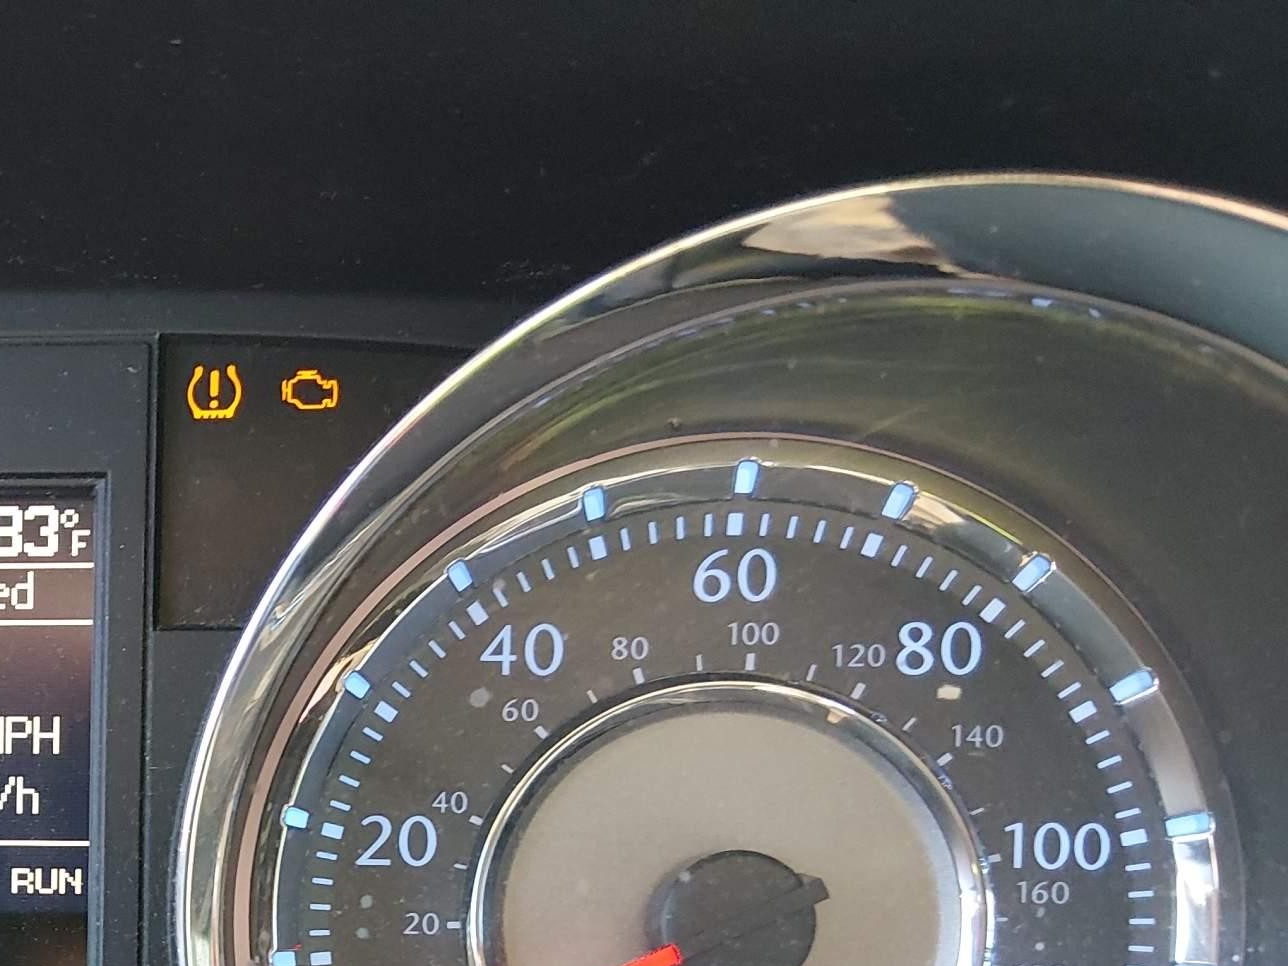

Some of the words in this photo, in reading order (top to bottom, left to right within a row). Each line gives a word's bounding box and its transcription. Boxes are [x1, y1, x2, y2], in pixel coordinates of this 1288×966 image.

[692, 547, 777, 604] 60
[727, 622, 780, 646] 100
[479, 624, 565, 676] 40
[612, 637, 649, 661] 80
[832, 642, 885, 668] 120
[896, 621, 983, 677] 80
[502, 698, 539, 725] 60
[952, 723, 1004, 749] 140
[432, 791, 468, 815] 40
[356, 815, 437, 869] 20
[1004, 821, 1110, 871] 100
[11, 867, 82, 895] RUN
[1018, 880, 1069, 906] 160
[403, 912, 439, 937] 20
